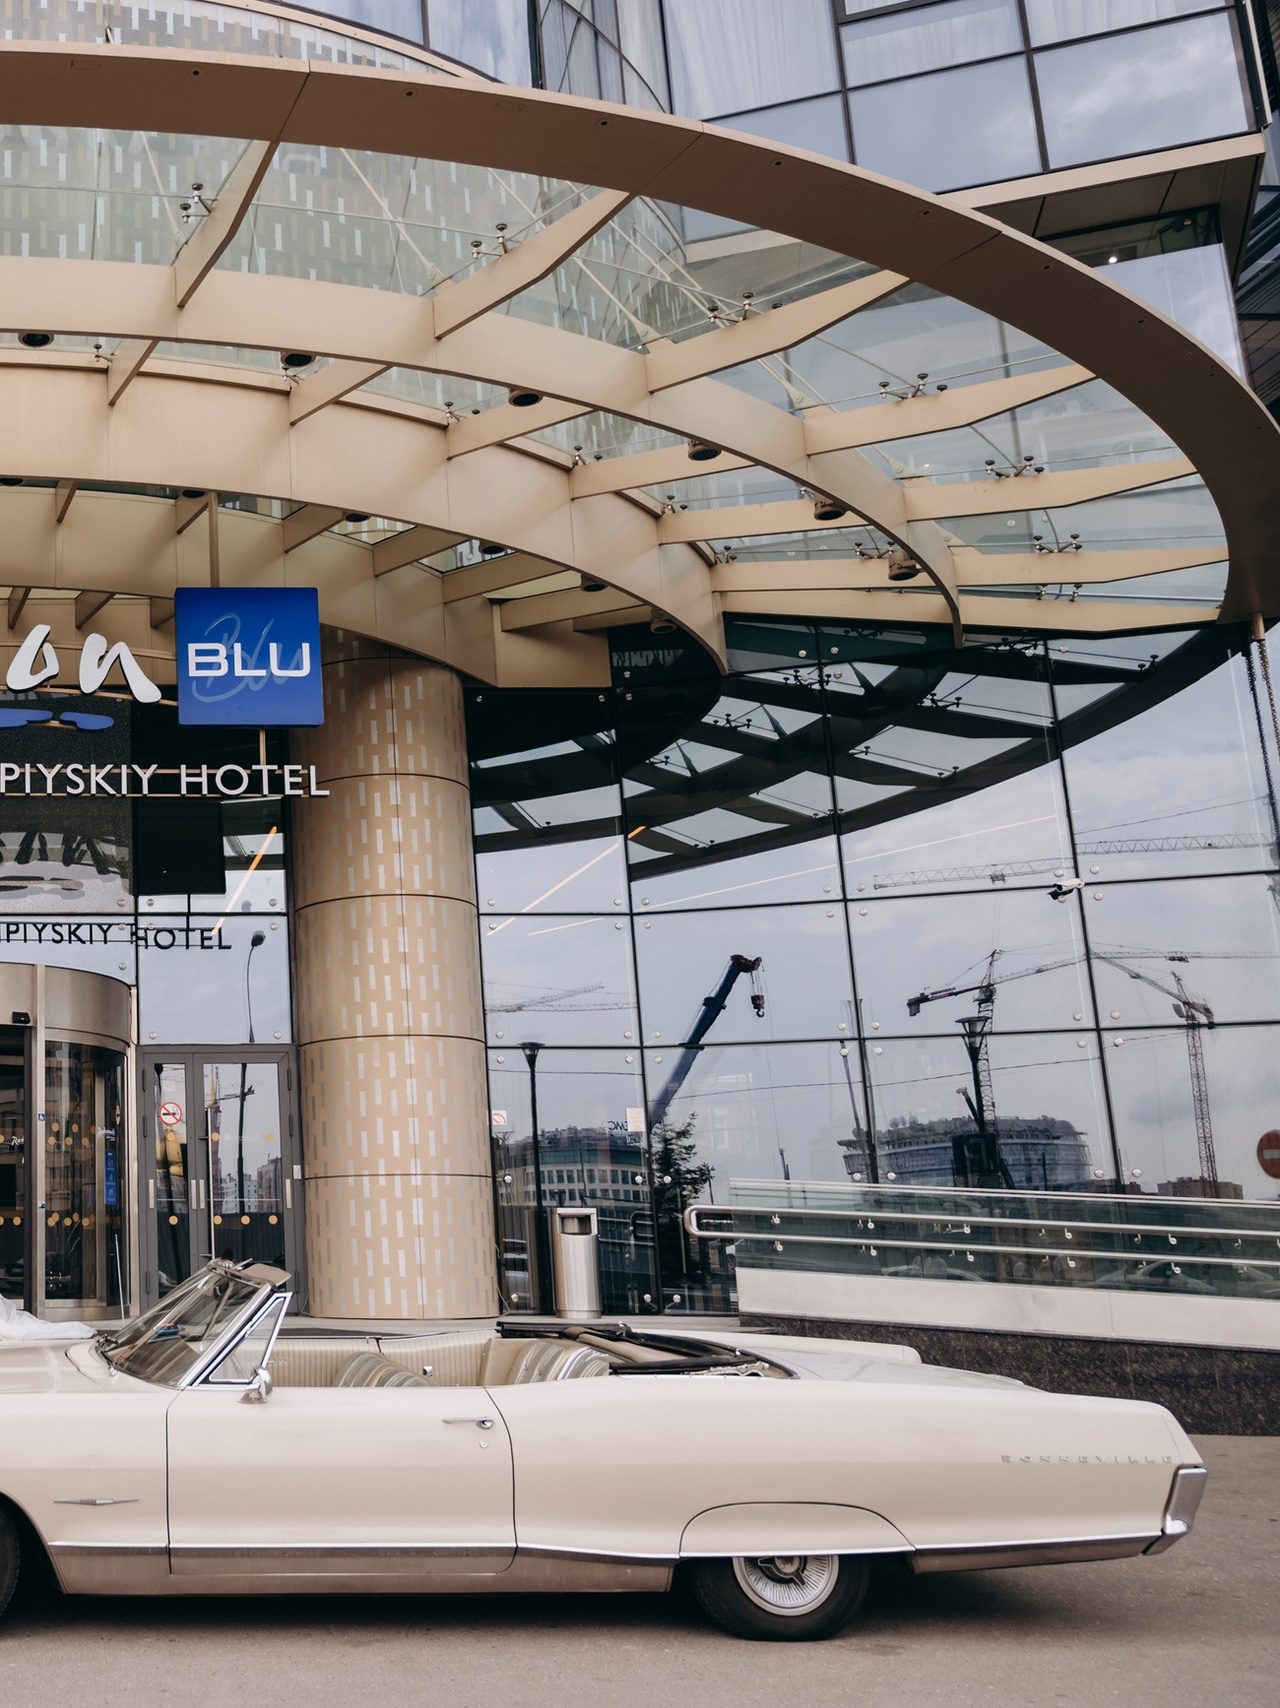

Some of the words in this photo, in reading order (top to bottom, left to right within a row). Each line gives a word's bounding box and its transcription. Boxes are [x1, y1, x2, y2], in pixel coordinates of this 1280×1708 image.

[188, 642, 311, 678] BLU
[180, 764, 330, 797] HOTEL
[1001, 1454, 1172, 1464] BONNEVILLE
